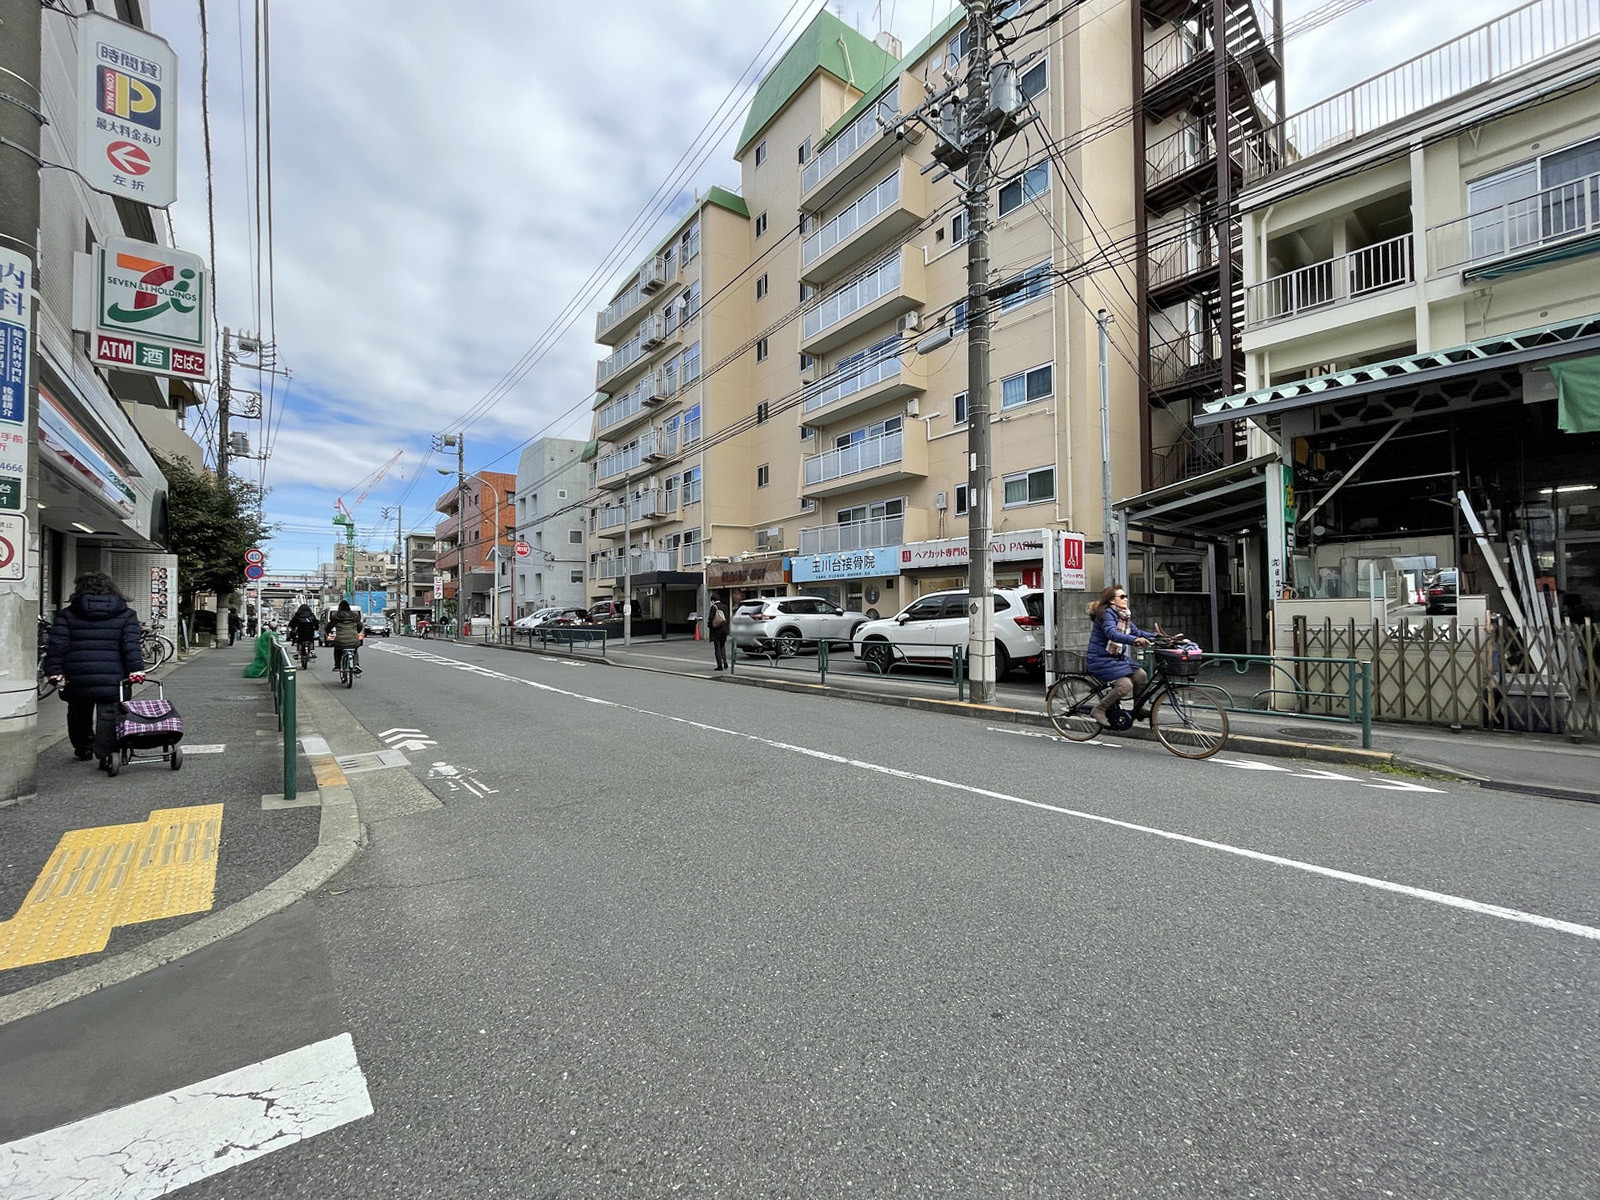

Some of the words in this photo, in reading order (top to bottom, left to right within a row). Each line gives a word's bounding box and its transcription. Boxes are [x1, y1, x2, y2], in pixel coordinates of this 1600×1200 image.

[101, 45, 158, 79] 時間貸
[96, 117, 161, 147] 最大料金あり
[113, 174, 145, 192] 左折
[151, 286, 197, 302] HOLDINGS
[100, 340, 132, 361] ATM
[142, 346, 164, 365] 酒
[173, 352, 204, 372] たばこ
[0, 463, 24, 473] 4666
[915, 547, 968, 559] ヘアカット専門店
[812, 555, 876, 573] 玉川台接骨院
